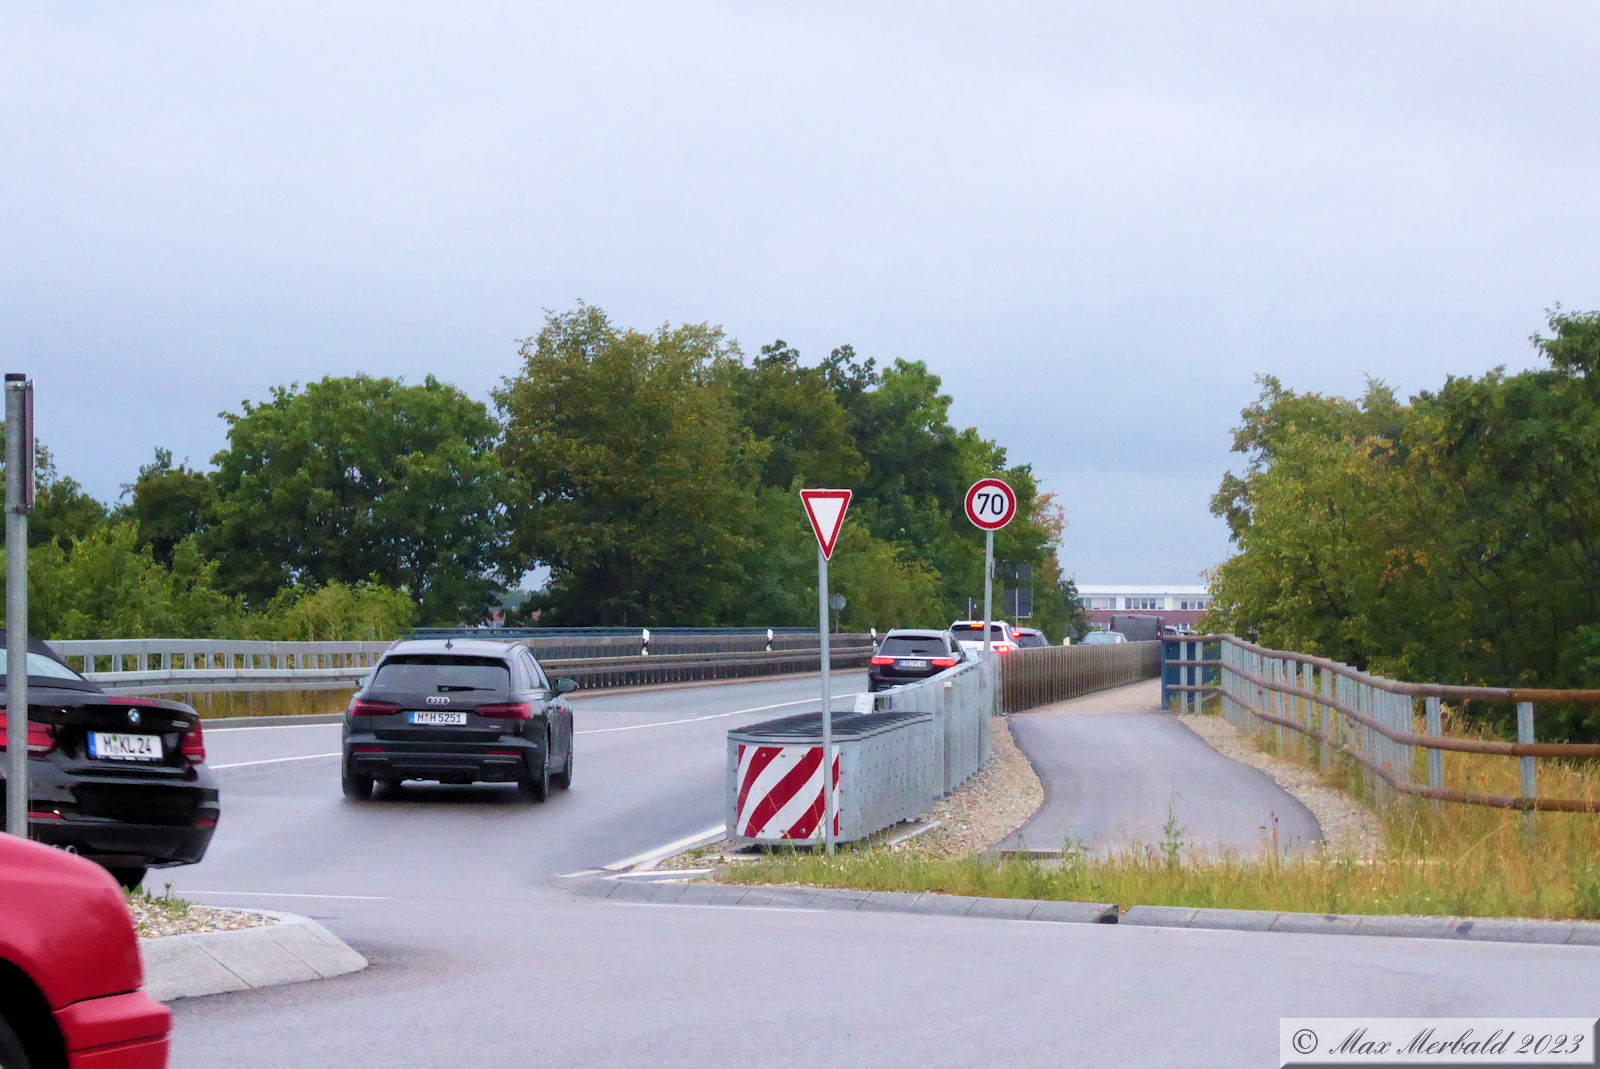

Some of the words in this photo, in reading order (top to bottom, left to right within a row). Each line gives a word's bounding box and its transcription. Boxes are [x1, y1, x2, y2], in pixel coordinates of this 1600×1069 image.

[977, 493, 1004, 515] 70
[417, 714, 424, 722] M
[430, 714, 436, 722] H
[438, 714, 461, 723] 5251
[103, 735, 112, 753] M
[120, 736, 135, 754] KL
[137, 737, 152, 755] 24
